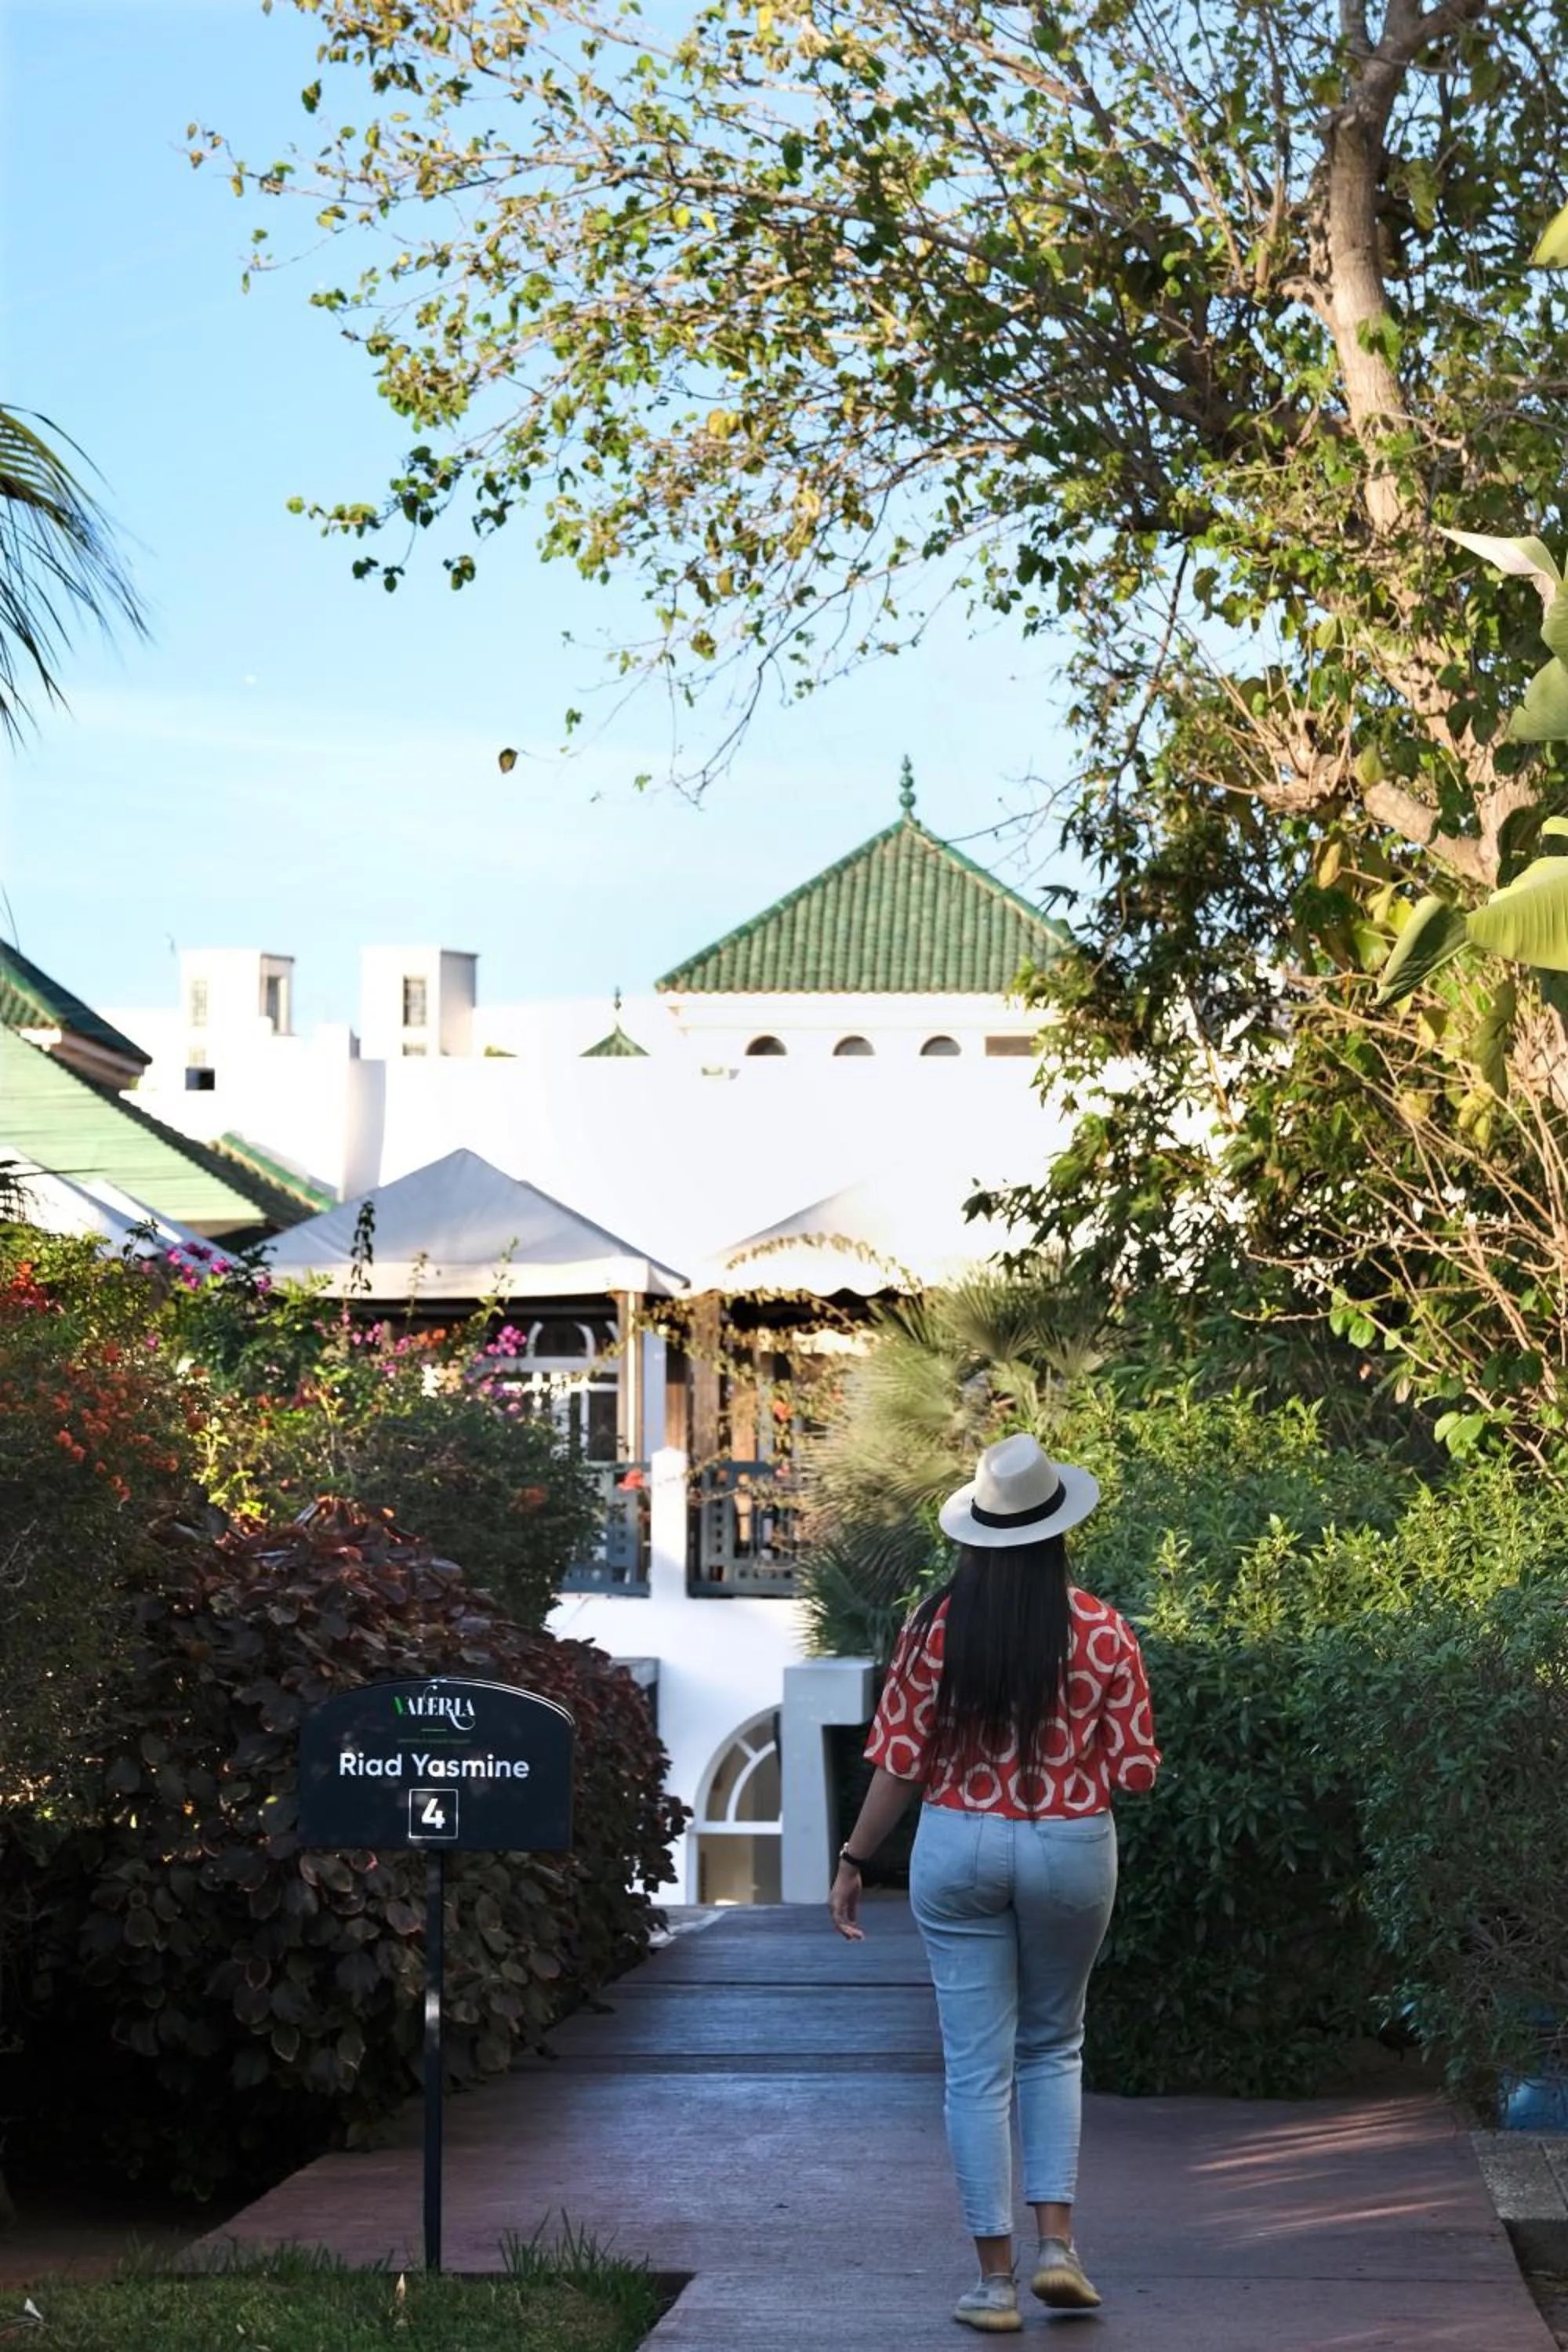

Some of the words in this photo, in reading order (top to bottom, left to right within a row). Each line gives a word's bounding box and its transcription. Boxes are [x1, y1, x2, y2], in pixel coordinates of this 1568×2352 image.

[339, 1752, 402, 1777] Riad
[412, 1753, 531, 1778] Yasmine
[421, 1798, 446, 1829] 4
